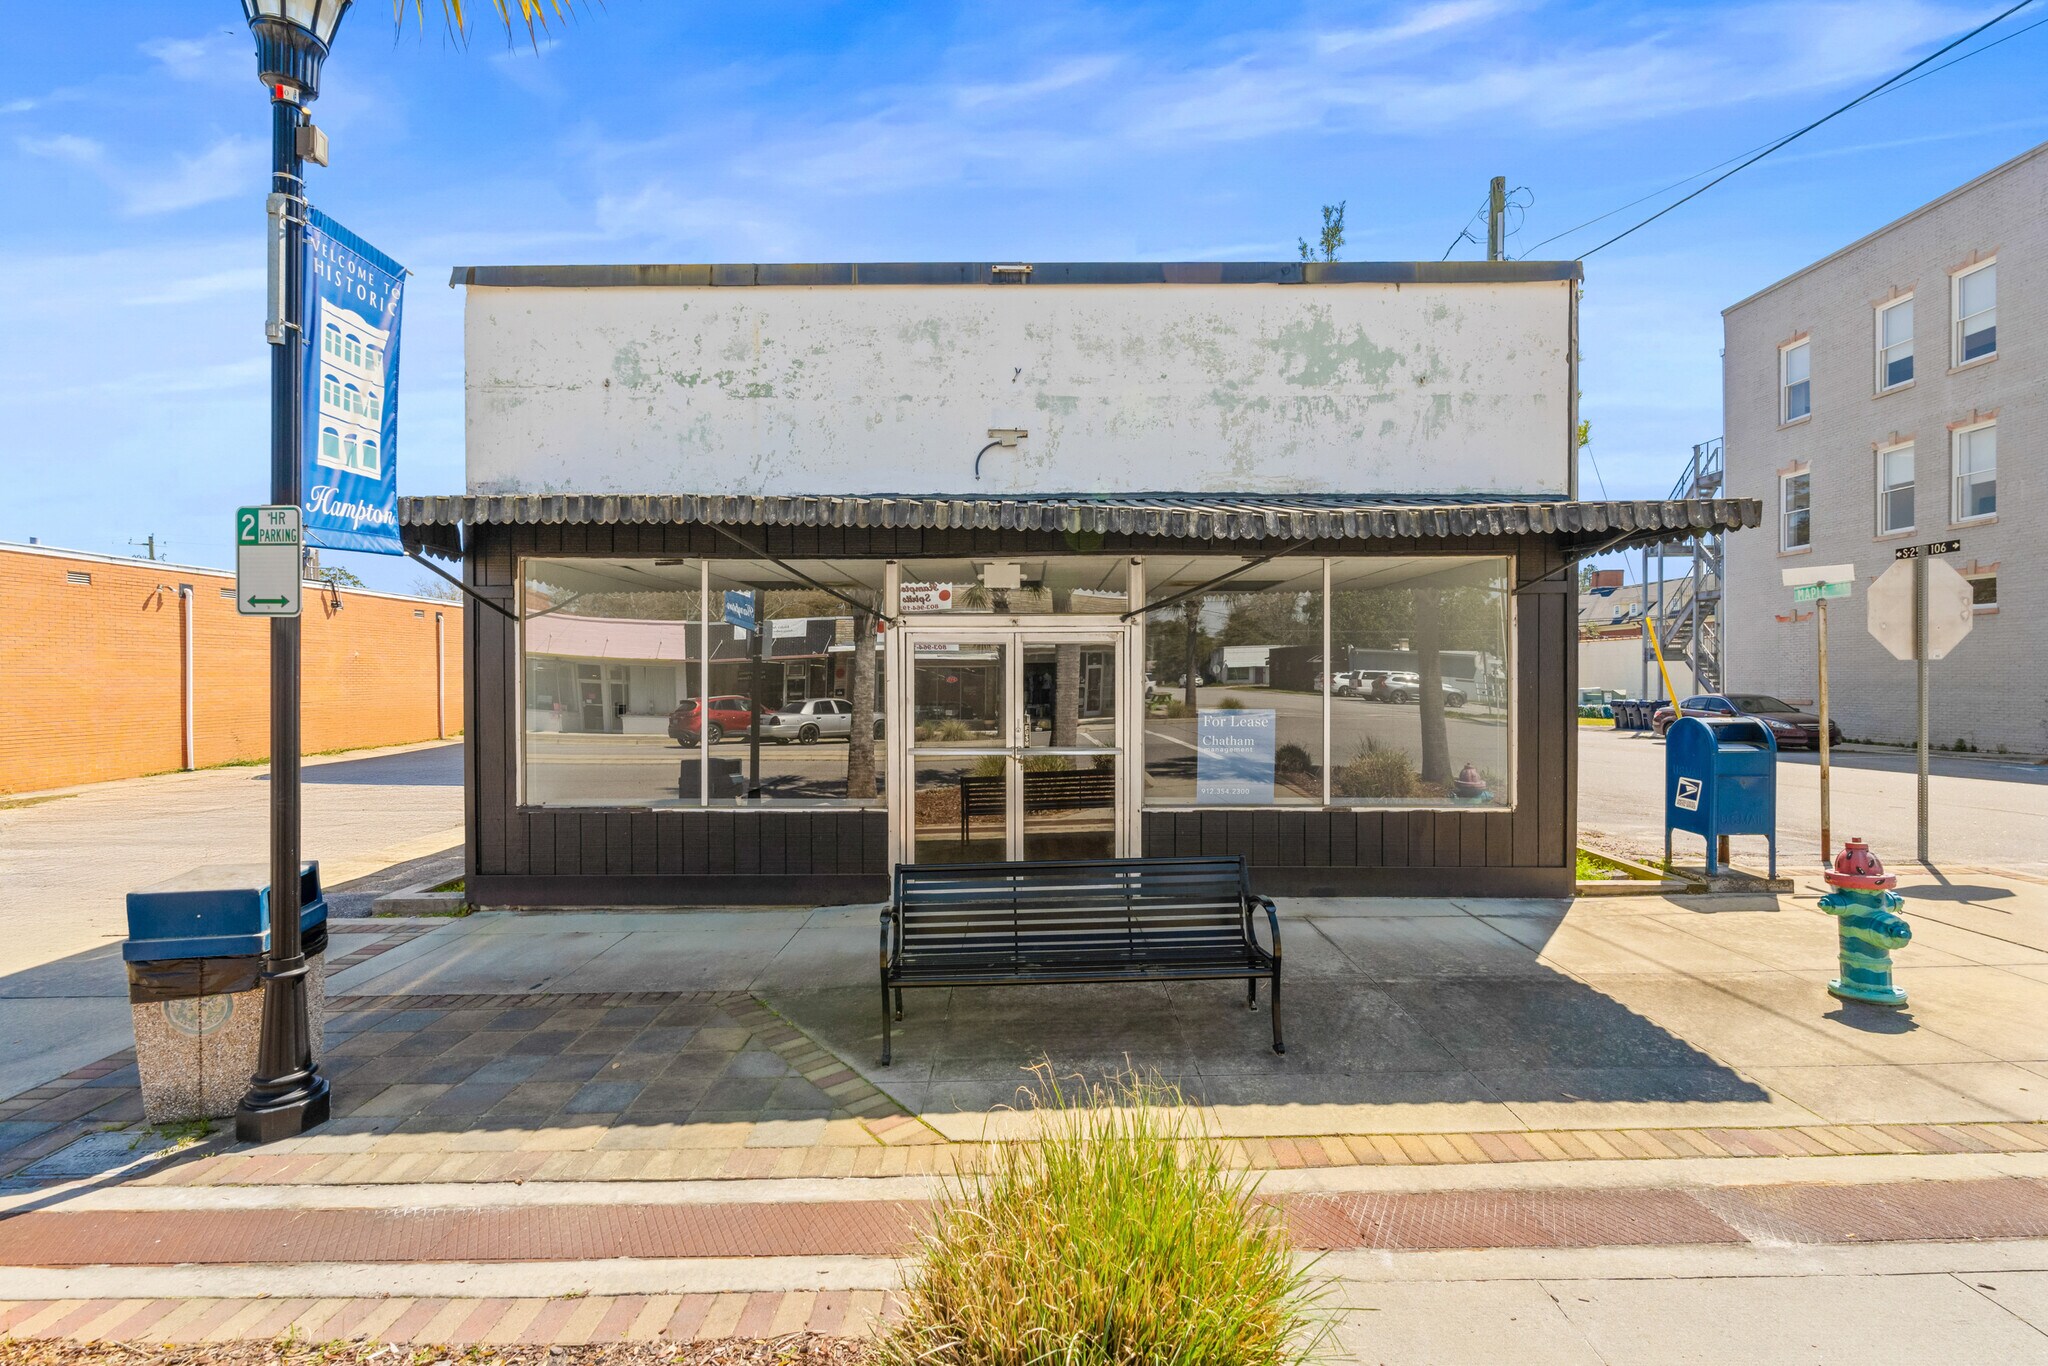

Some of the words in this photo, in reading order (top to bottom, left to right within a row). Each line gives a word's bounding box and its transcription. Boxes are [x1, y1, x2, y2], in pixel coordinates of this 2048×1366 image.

[314, 257, 397, 316] HISTORIC
[384, 282, 401, 300] TO
[305, 485, 395, 530] Hampton
[241, 513, 256, 541] 2
[270, 511, 285, 525] HR
[259, 528, 297, 542] PARKING
[1931, 543, 1946, 555] 106
[1203, 715, 1226, 727] For
[1231, 715, 1269, 727] Lease
[1202, 735, 1255, 746] Chatham
